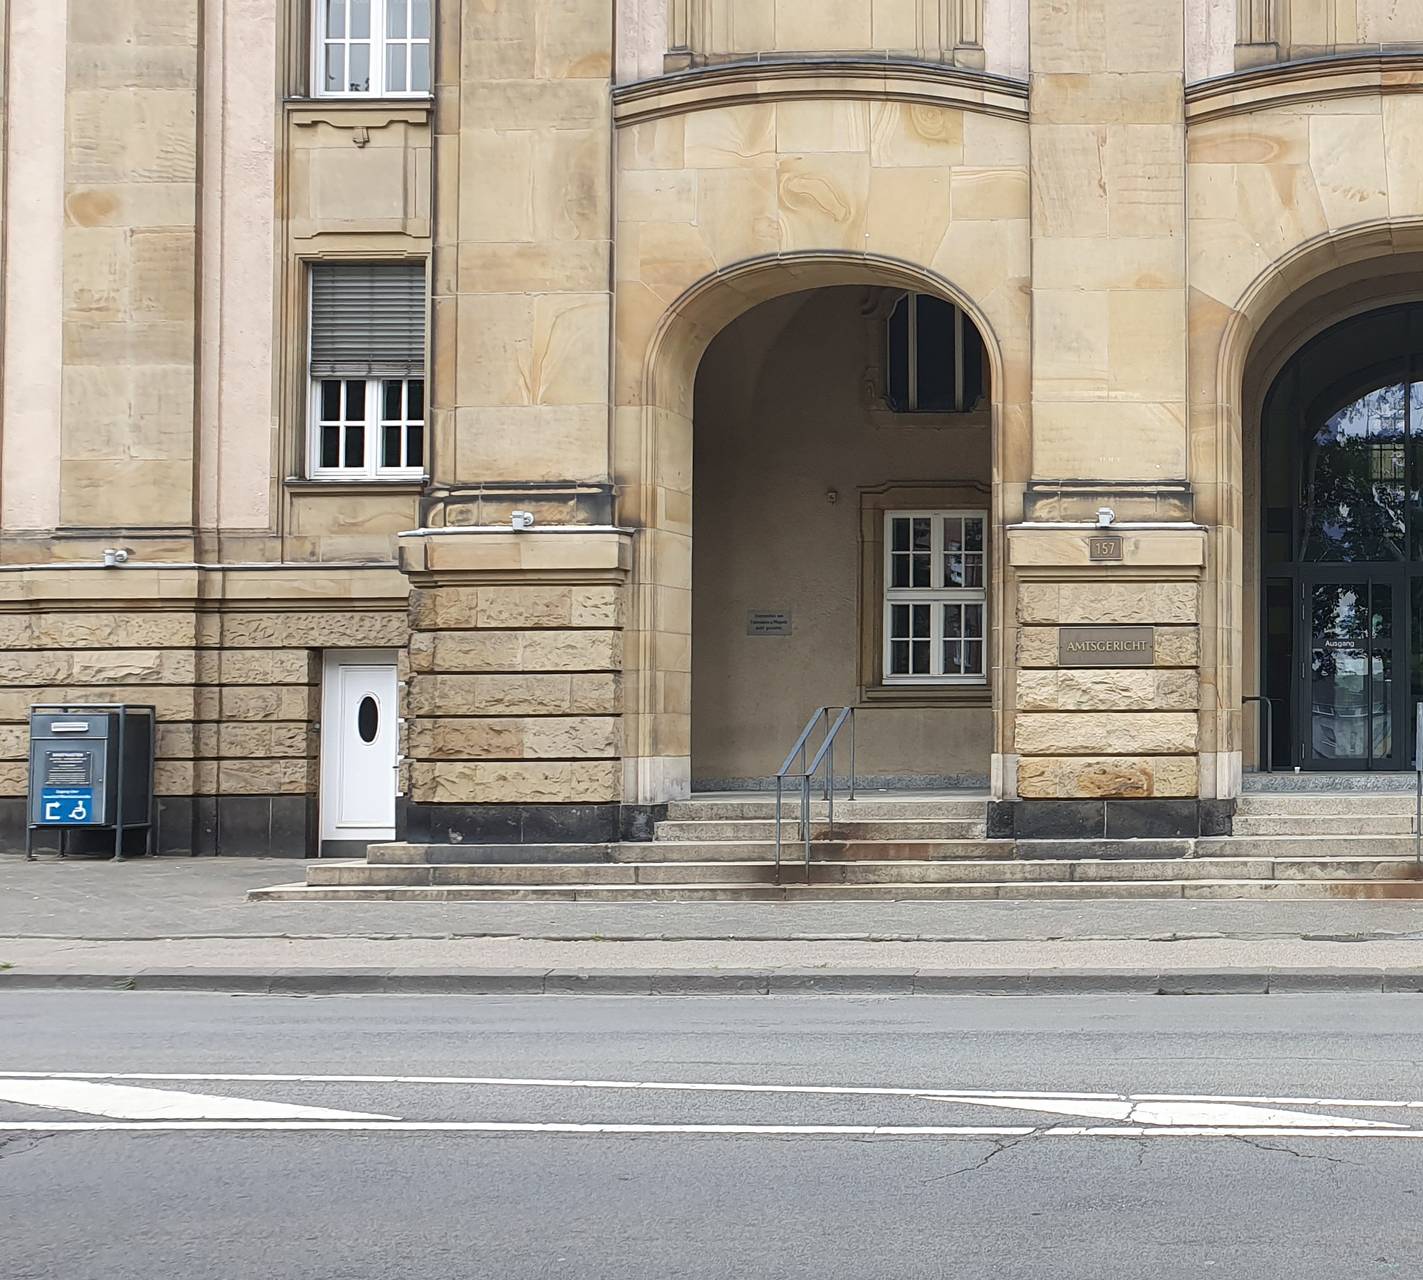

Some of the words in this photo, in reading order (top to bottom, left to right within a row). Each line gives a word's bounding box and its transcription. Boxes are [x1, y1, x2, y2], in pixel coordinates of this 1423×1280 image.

[1095, 542, 1115, 555] 157
[1066, 640, 1148, 652] AMTSGERICHT
[1325, 640, 1355, 648] Ausgang
